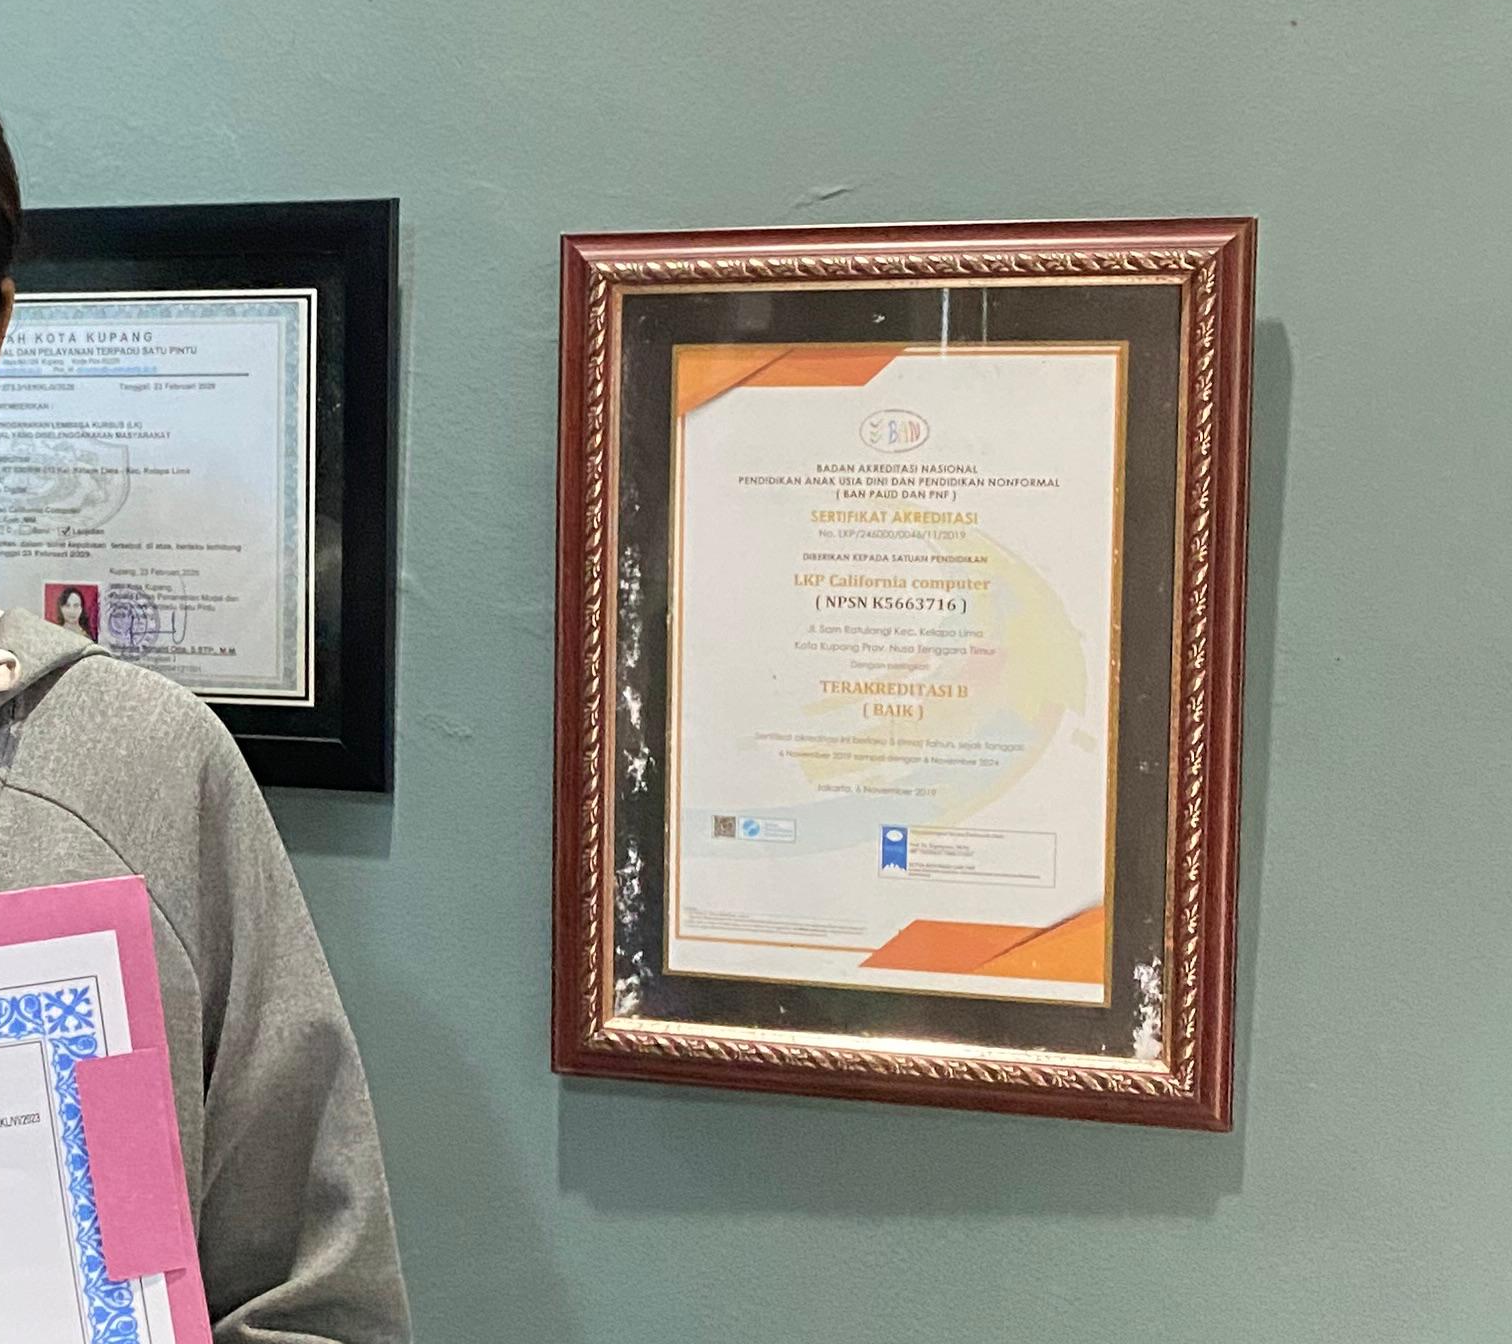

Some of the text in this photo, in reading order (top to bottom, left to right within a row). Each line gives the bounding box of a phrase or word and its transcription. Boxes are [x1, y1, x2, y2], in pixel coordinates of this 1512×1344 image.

[35, 331, 153, 343] KOTA KUPANG
[16, 346, 197, 357] DAN PELAYANAN TERPADU SATU PINTU
[816, 463, 978, 475] BADAN AKREDITASI NASIONAL
[738, 476, 1061, 488] PENDIDIKAN ANAK USIA DINI DAN PENDIDIKAN NONFORMAL
[843, 489, 950, 500] BAN PAUD DAN PNF
[810, 509, 979, 525] SERTIFIKAT AKREDITASI
[802, 552, 988, 564] DIBERIKAN KEPADA SATUAN PENDIDIKAN
[793, 573, 992, 593] LKP California computer
[825, 595, 957, 611] NPSN K5663716
[819, 680, 969, 698] TERAKREDITASI B
[873, 703, 914, 718] BAIK
